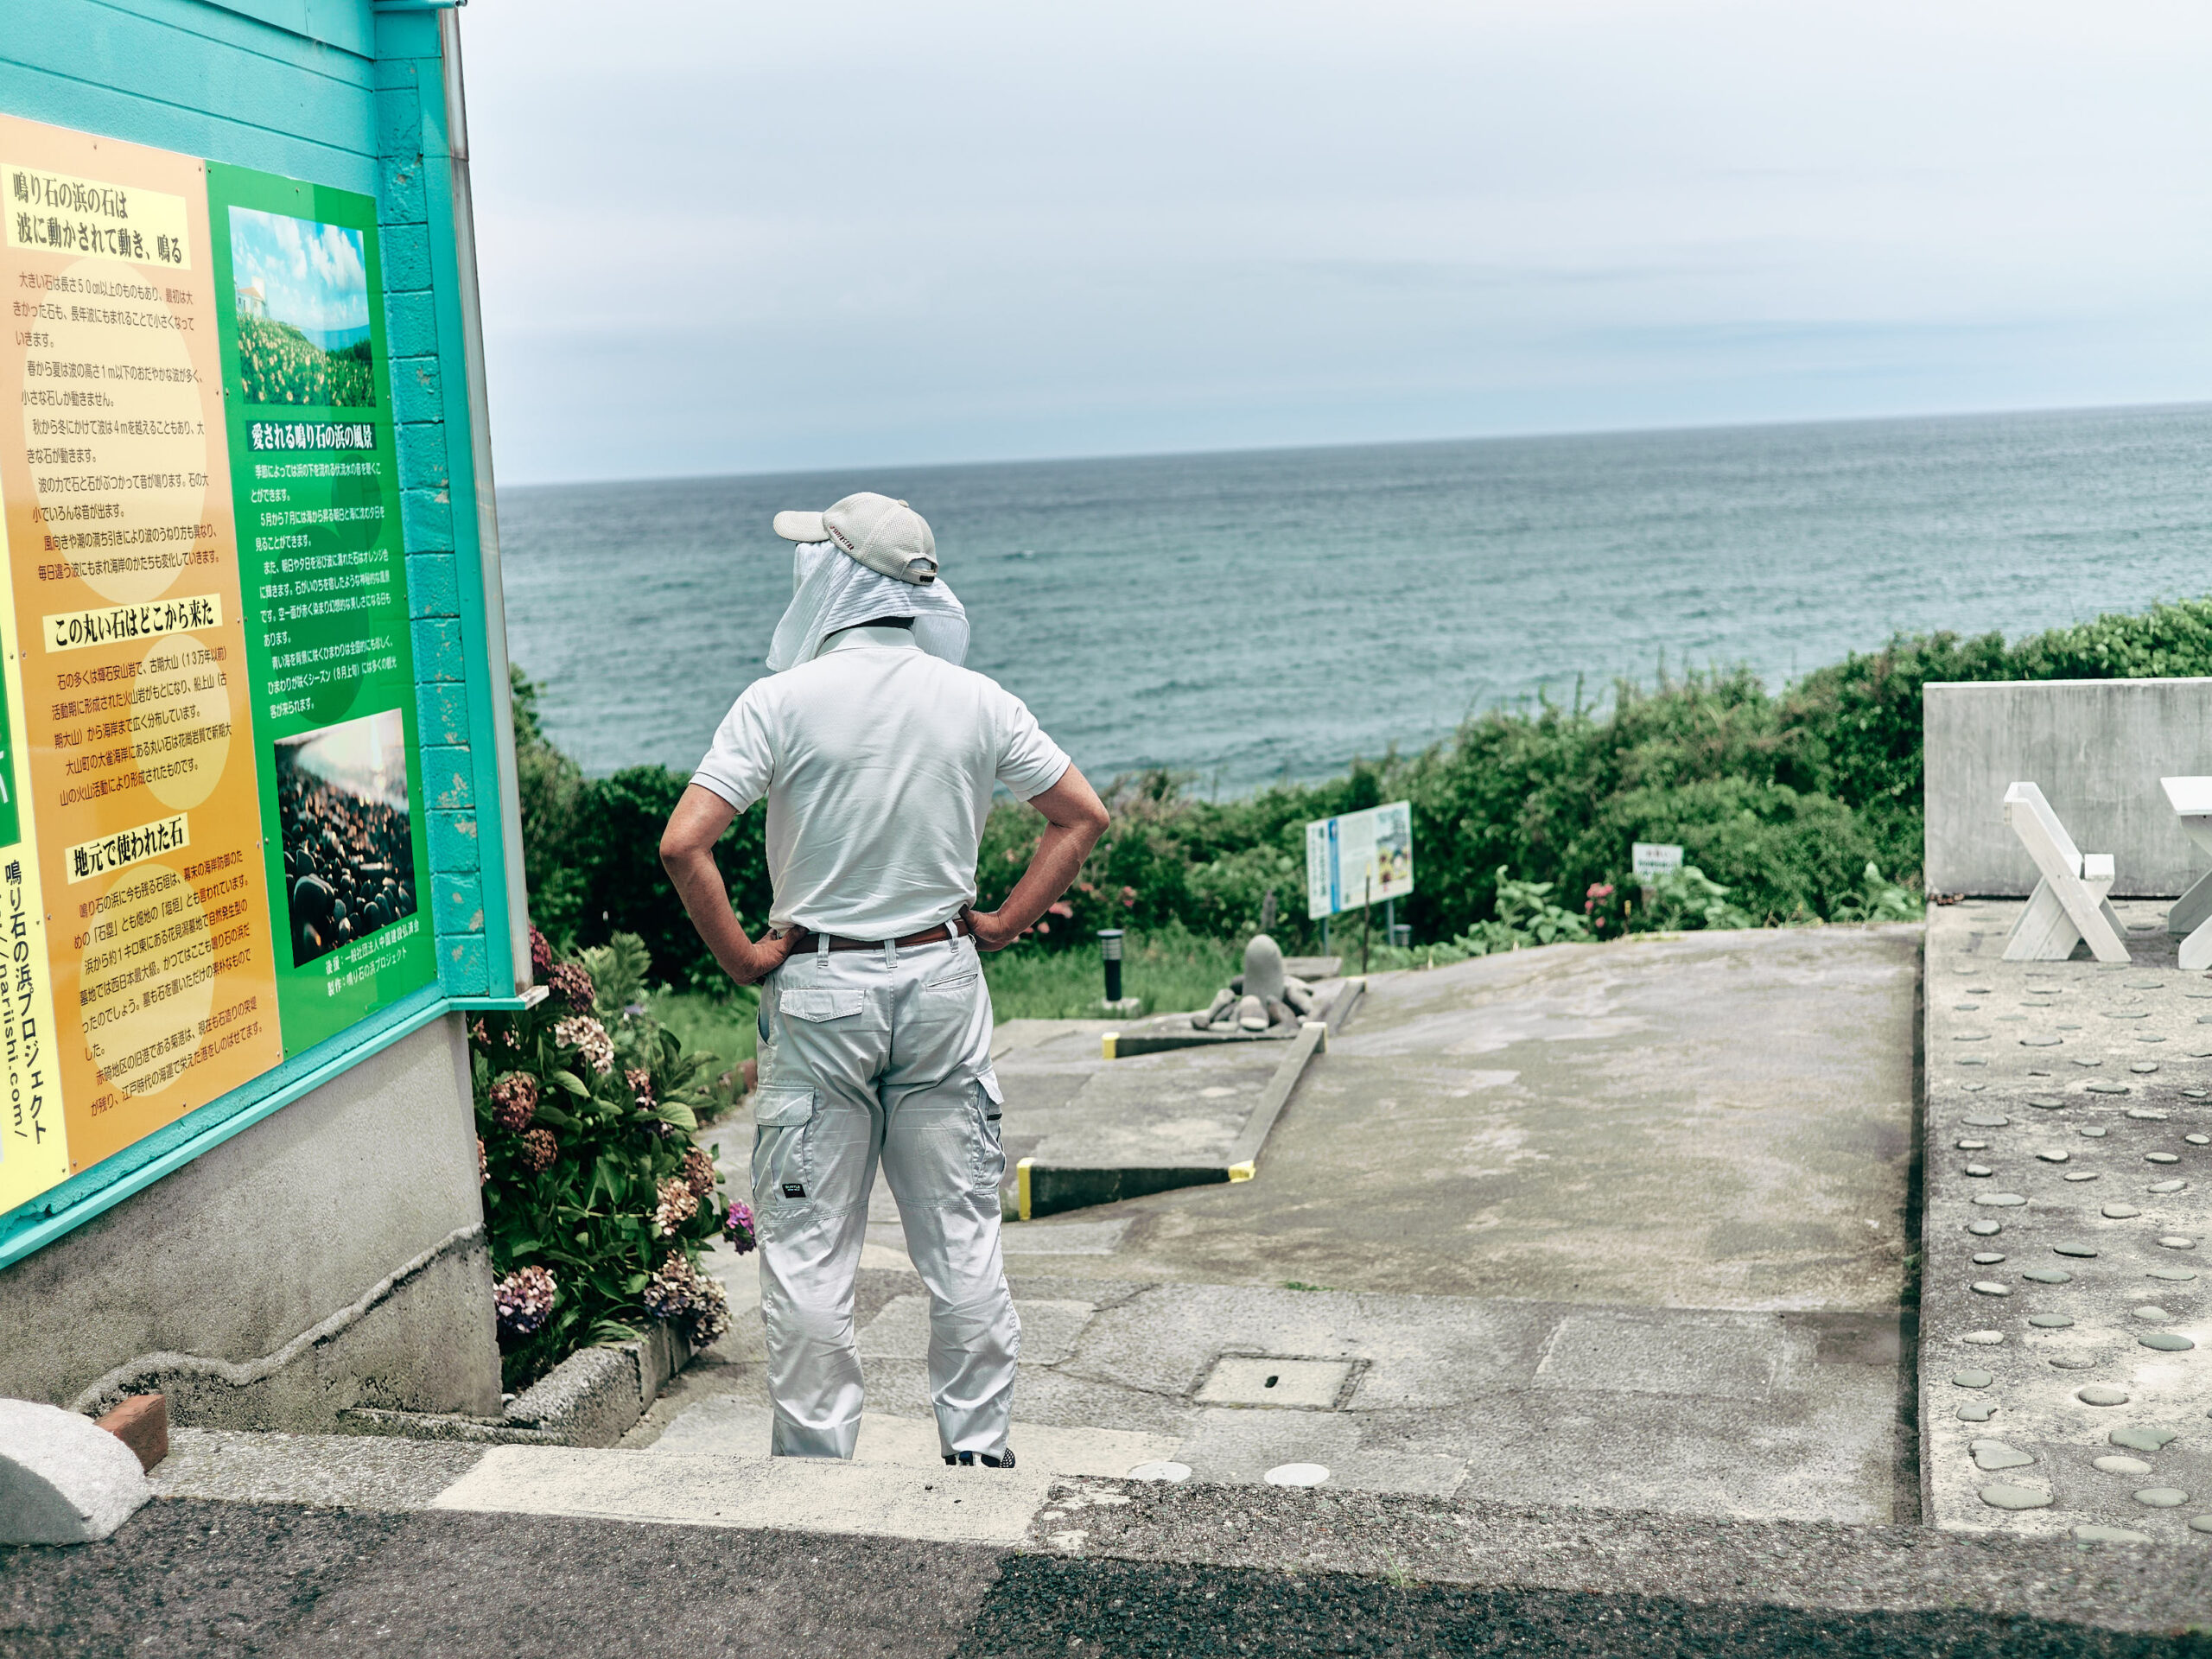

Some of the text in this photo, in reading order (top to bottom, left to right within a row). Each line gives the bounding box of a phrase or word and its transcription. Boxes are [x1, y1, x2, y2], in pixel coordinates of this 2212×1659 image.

[13, 172, 128, 219] 鳴り石の浜の石は
[16, 212, 181, 264] 波に動かされて動き、鳴る
[13, 302, 194, 331] きかった石も、長年波にもまれることで小さくなって
[16, 330, 54, 347] いきます。
[22, 390, 115, 407] 小さな石しか動きません。
[251, 423, 373, 450] 愛される鳴り石の浜の風景
[27, 448, 97, 464] きな石が動きます。
[38, 473, 209, 493] 波の力で石と石がぶつかって音が鳴ります。石の大
[251, 489, 290, 503] とができます。
[33, 503, 124, 523] 小でいろんな音が出ます。
[44, 524, 218, 551] 風向きや潮の満ち引きにより波のうねり方も異なり、
[256, 536, 311, 552] 見ることができます。
[38, 550, 219, 581] 毎日違う波にもまれ海岸のかたちも変化していきます。
[55, 597, 213, 646] この丸い石はどこから来た
[264, 632, 291, 647] あります。
[270, 698, 315, 719] 客が来られます。
[54, 705, 200, 749] 期大山）から海岸まで広く分布しています。
[60, 758, 199, 807] 山の火山活動により形成されたものです。
[73, 817, 183, 878] 地元で使われた石
[79, 850, 244, 918] 鳴り石の浜に今も残る石垣は、幕末の海岸防御のた
[79, 923, 251, 1006] 墓地では西日本最大級。かつてはここも鳴り石の浜だ
[5, 859, 47, 1145] 鳴り石の浜プロジェクト
[85, 1043, 105, 1061] した。
